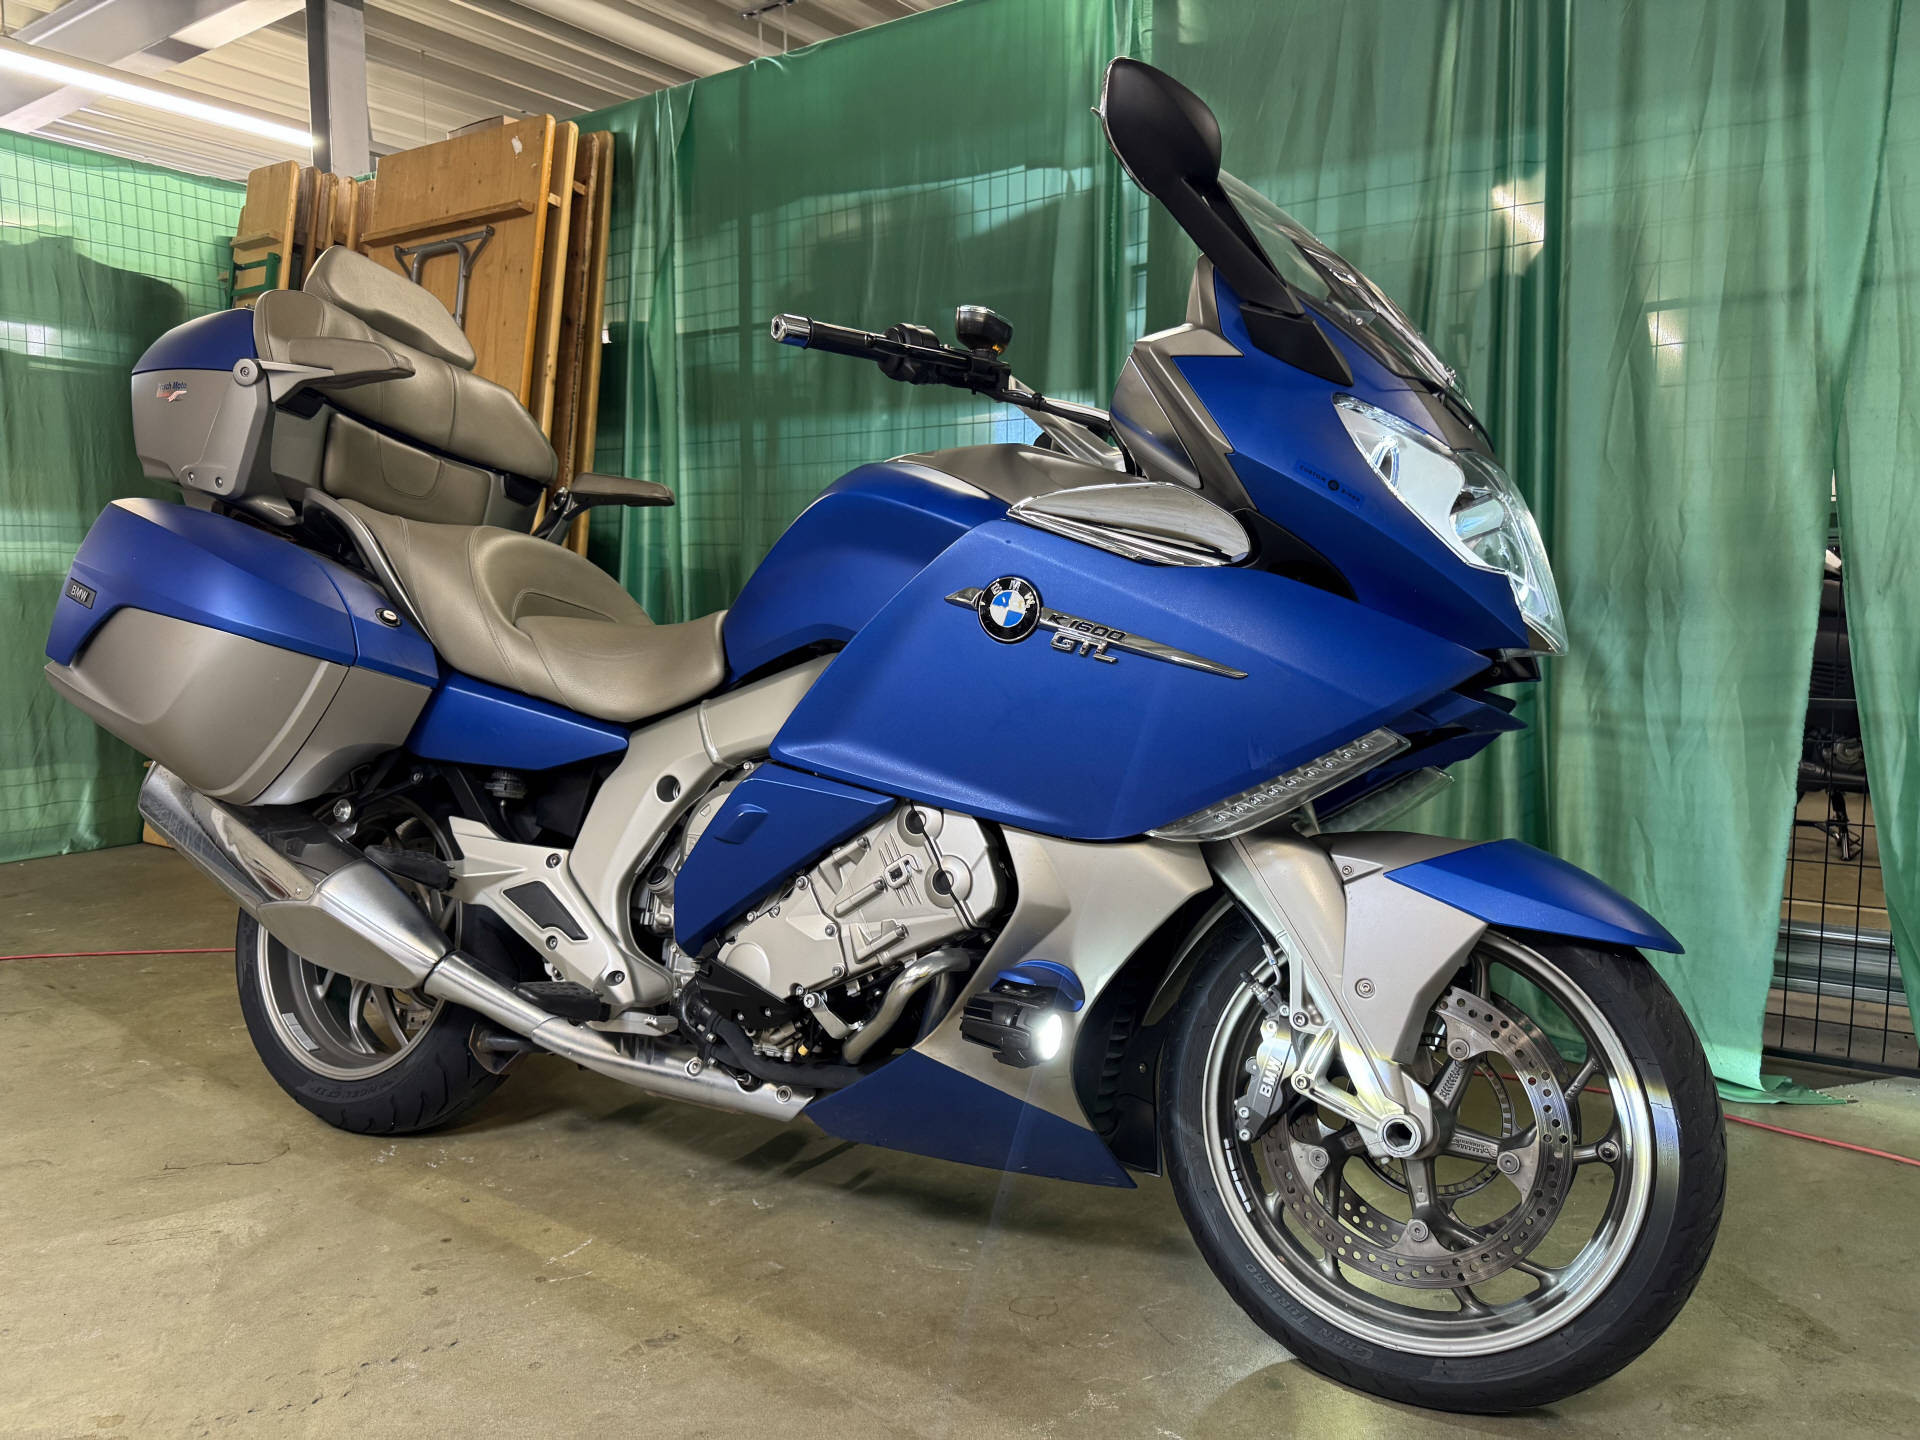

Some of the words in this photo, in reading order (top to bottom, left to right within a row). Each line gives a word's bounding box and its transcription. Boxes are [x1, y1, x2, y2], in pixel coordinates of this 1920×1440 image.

[70, 584, 89, 602] BMW
[1047, 612, 1070, 623] K
[1068, 620, 1127, 641] 1600
[1050, 630, 1118, 663] GTL
[1259, 1056, 1283, 1098] BMW
